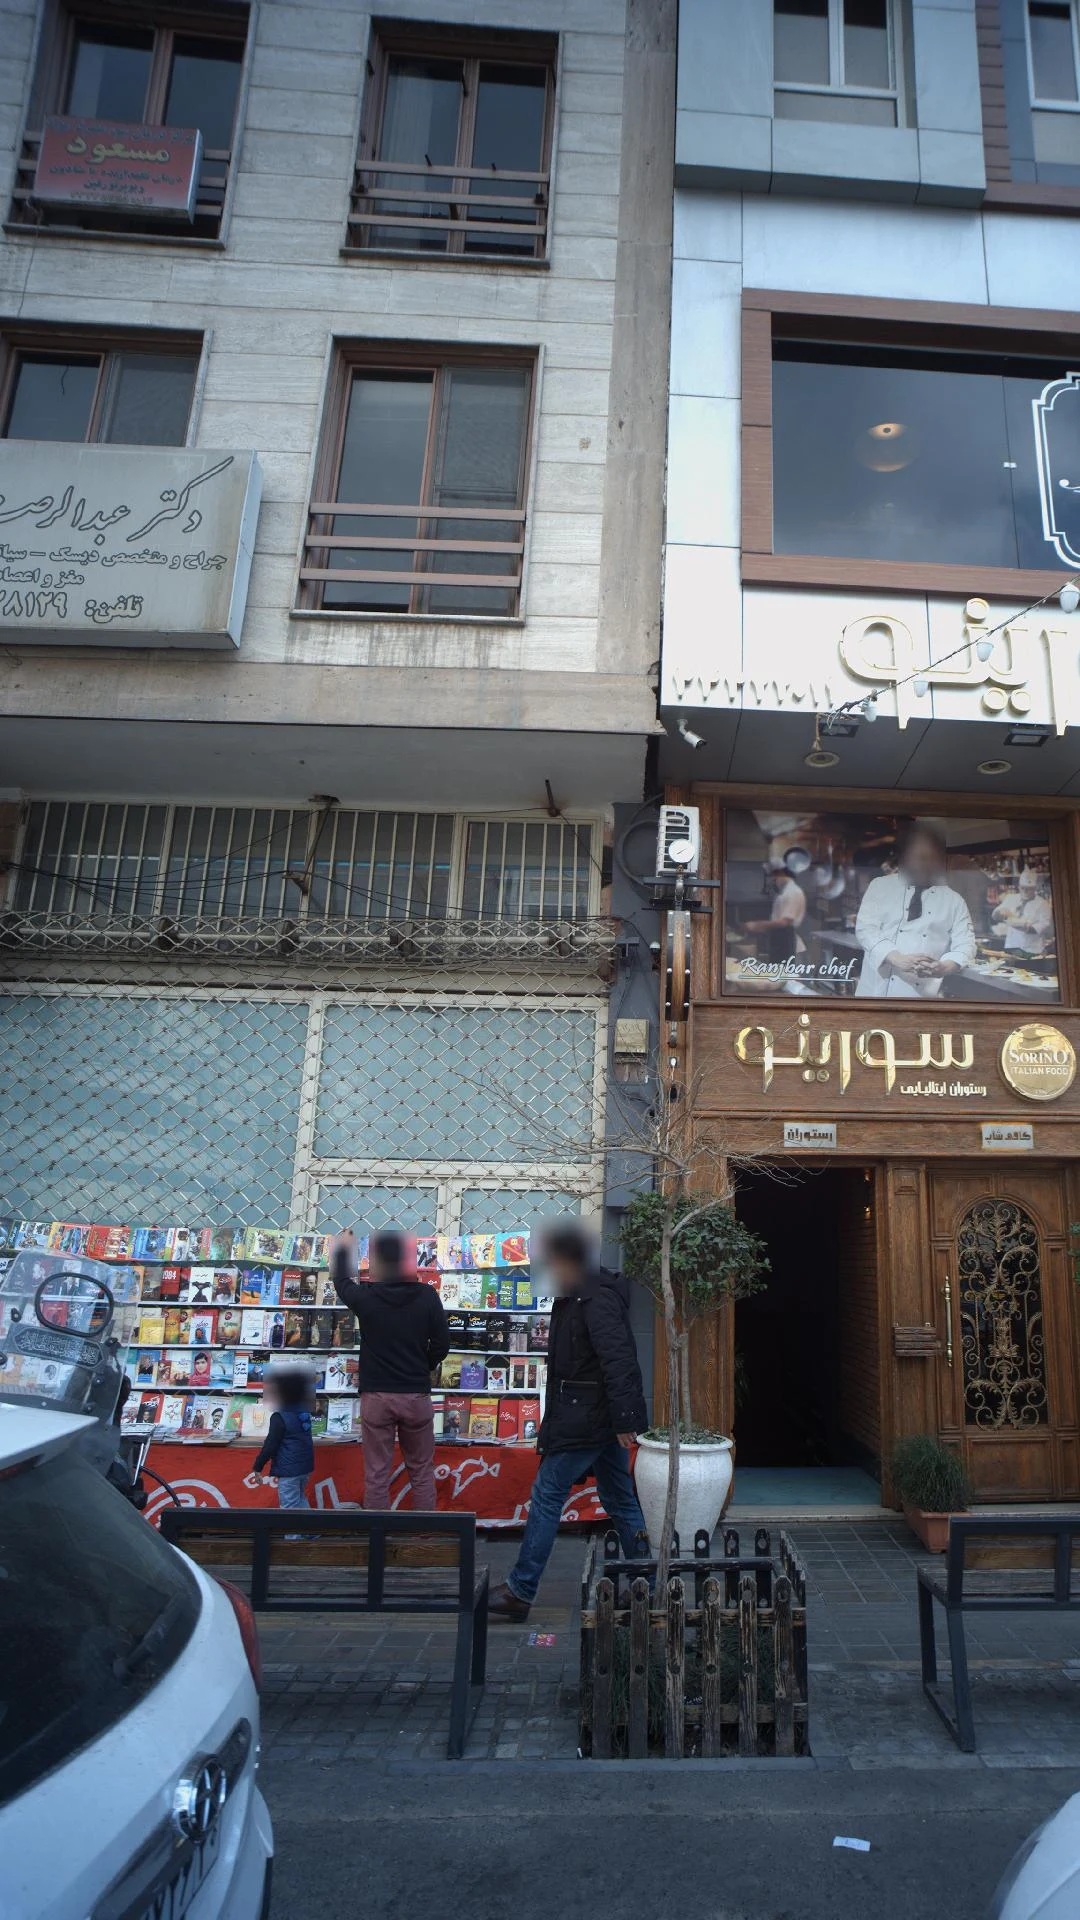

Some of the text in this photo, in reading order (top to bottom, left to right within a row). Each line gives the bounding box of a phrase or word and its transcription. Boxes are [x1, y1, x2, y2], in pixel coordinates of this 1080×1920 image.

[66, 136, 170, 164] مسعود
[0, 455, 235, 546] دکتر عبدالرض
[0, 543, 27, 566] سیا
[49, 546, 100, 566] دیسک
[101, 548, 168, 567] متخصص
[169, 554, 181, 570] و
[182, 550, 228, 571] جراح
[0, 567, 85, 589] مغز و اعصا
[0, 590, 144, 624] تلفن: ۸۱۲۹
[838, 596, 1071, 738] رینو
[738, 955, 857, 981] Ranjbar chef
[733, 1013, 974, 1095] سورینو
[1009, 1047, 1069, 1065] SORINO
[1010, 1066, 1069, 1076] ITALIAN FOOD
[949, 1081, 987, 1097] رستوران
[787, 1127, 833, 1143] رستوران
[162, 1269, 177, 1280] 1984
